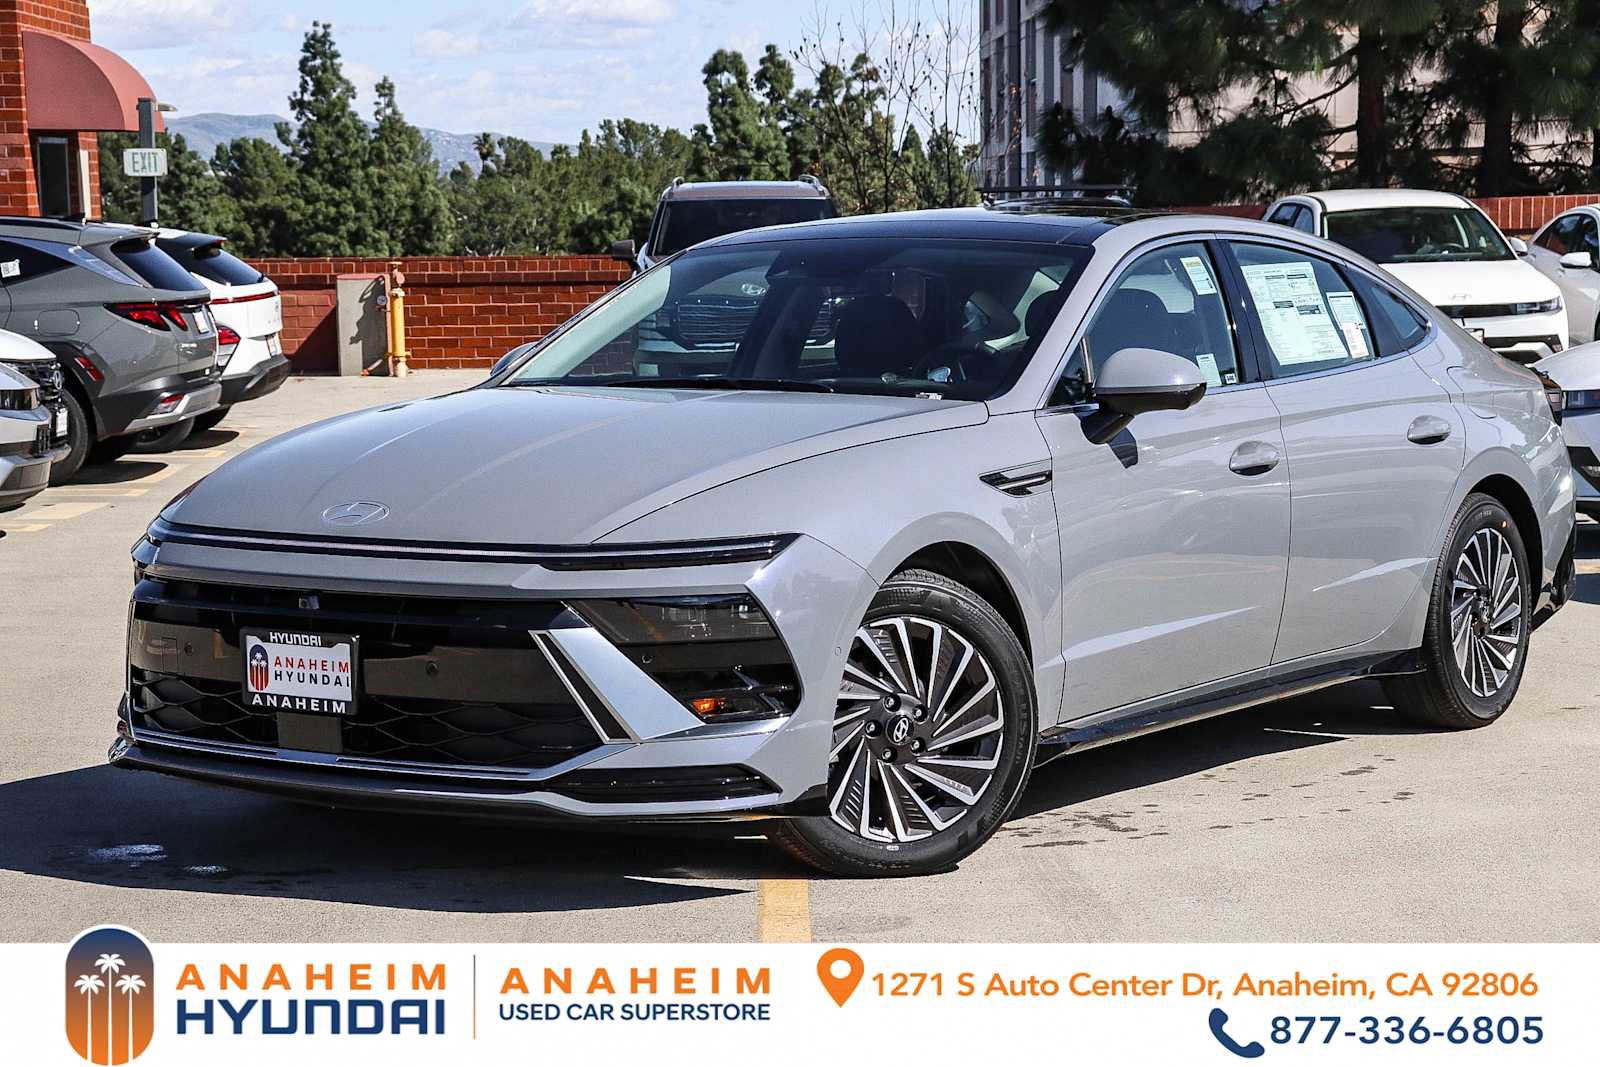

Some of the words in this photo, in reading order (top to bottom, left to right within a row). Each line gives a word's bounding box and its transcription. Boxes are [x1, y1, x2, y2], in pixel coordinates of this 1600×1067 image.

[132, 151, 158, 173] EXIT
[269, 631, 322, 647] HYUNDAI
[274, 655, 350, 674] ANAHEIM
[274, 670, 350, 688] HYUNDAI
[252, 693, 346, 714] ANAHEIM
